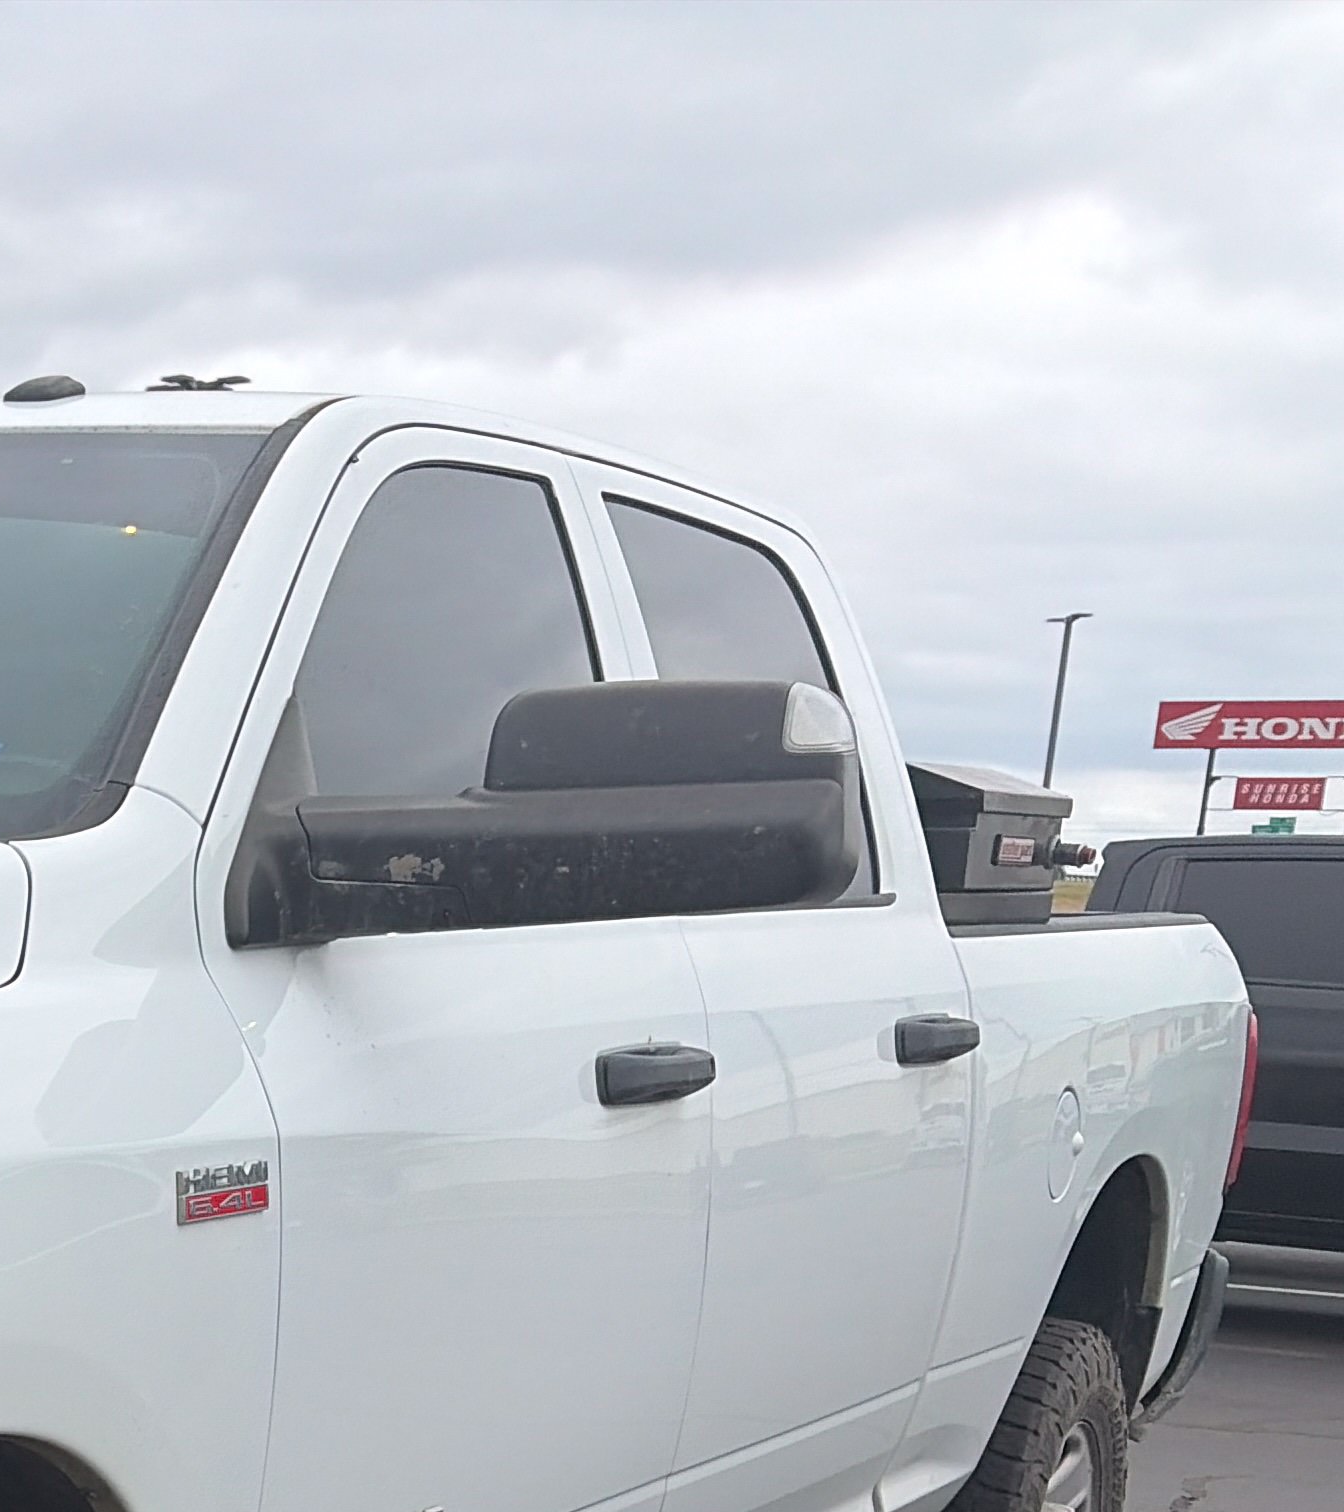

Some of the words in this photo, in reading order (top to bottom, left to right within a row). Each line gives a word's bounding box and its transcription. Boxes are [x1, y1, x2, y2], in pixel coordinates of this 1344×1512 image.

[1217, 717, 1344, 741] HON
[1240, 783, 1322, 795] SUNRISE
[1249, 794, 1310, 804] HONDA
[176, 1160, 269, 1195] HEMI
[189, 1190, 265, 1217] 6.4L
